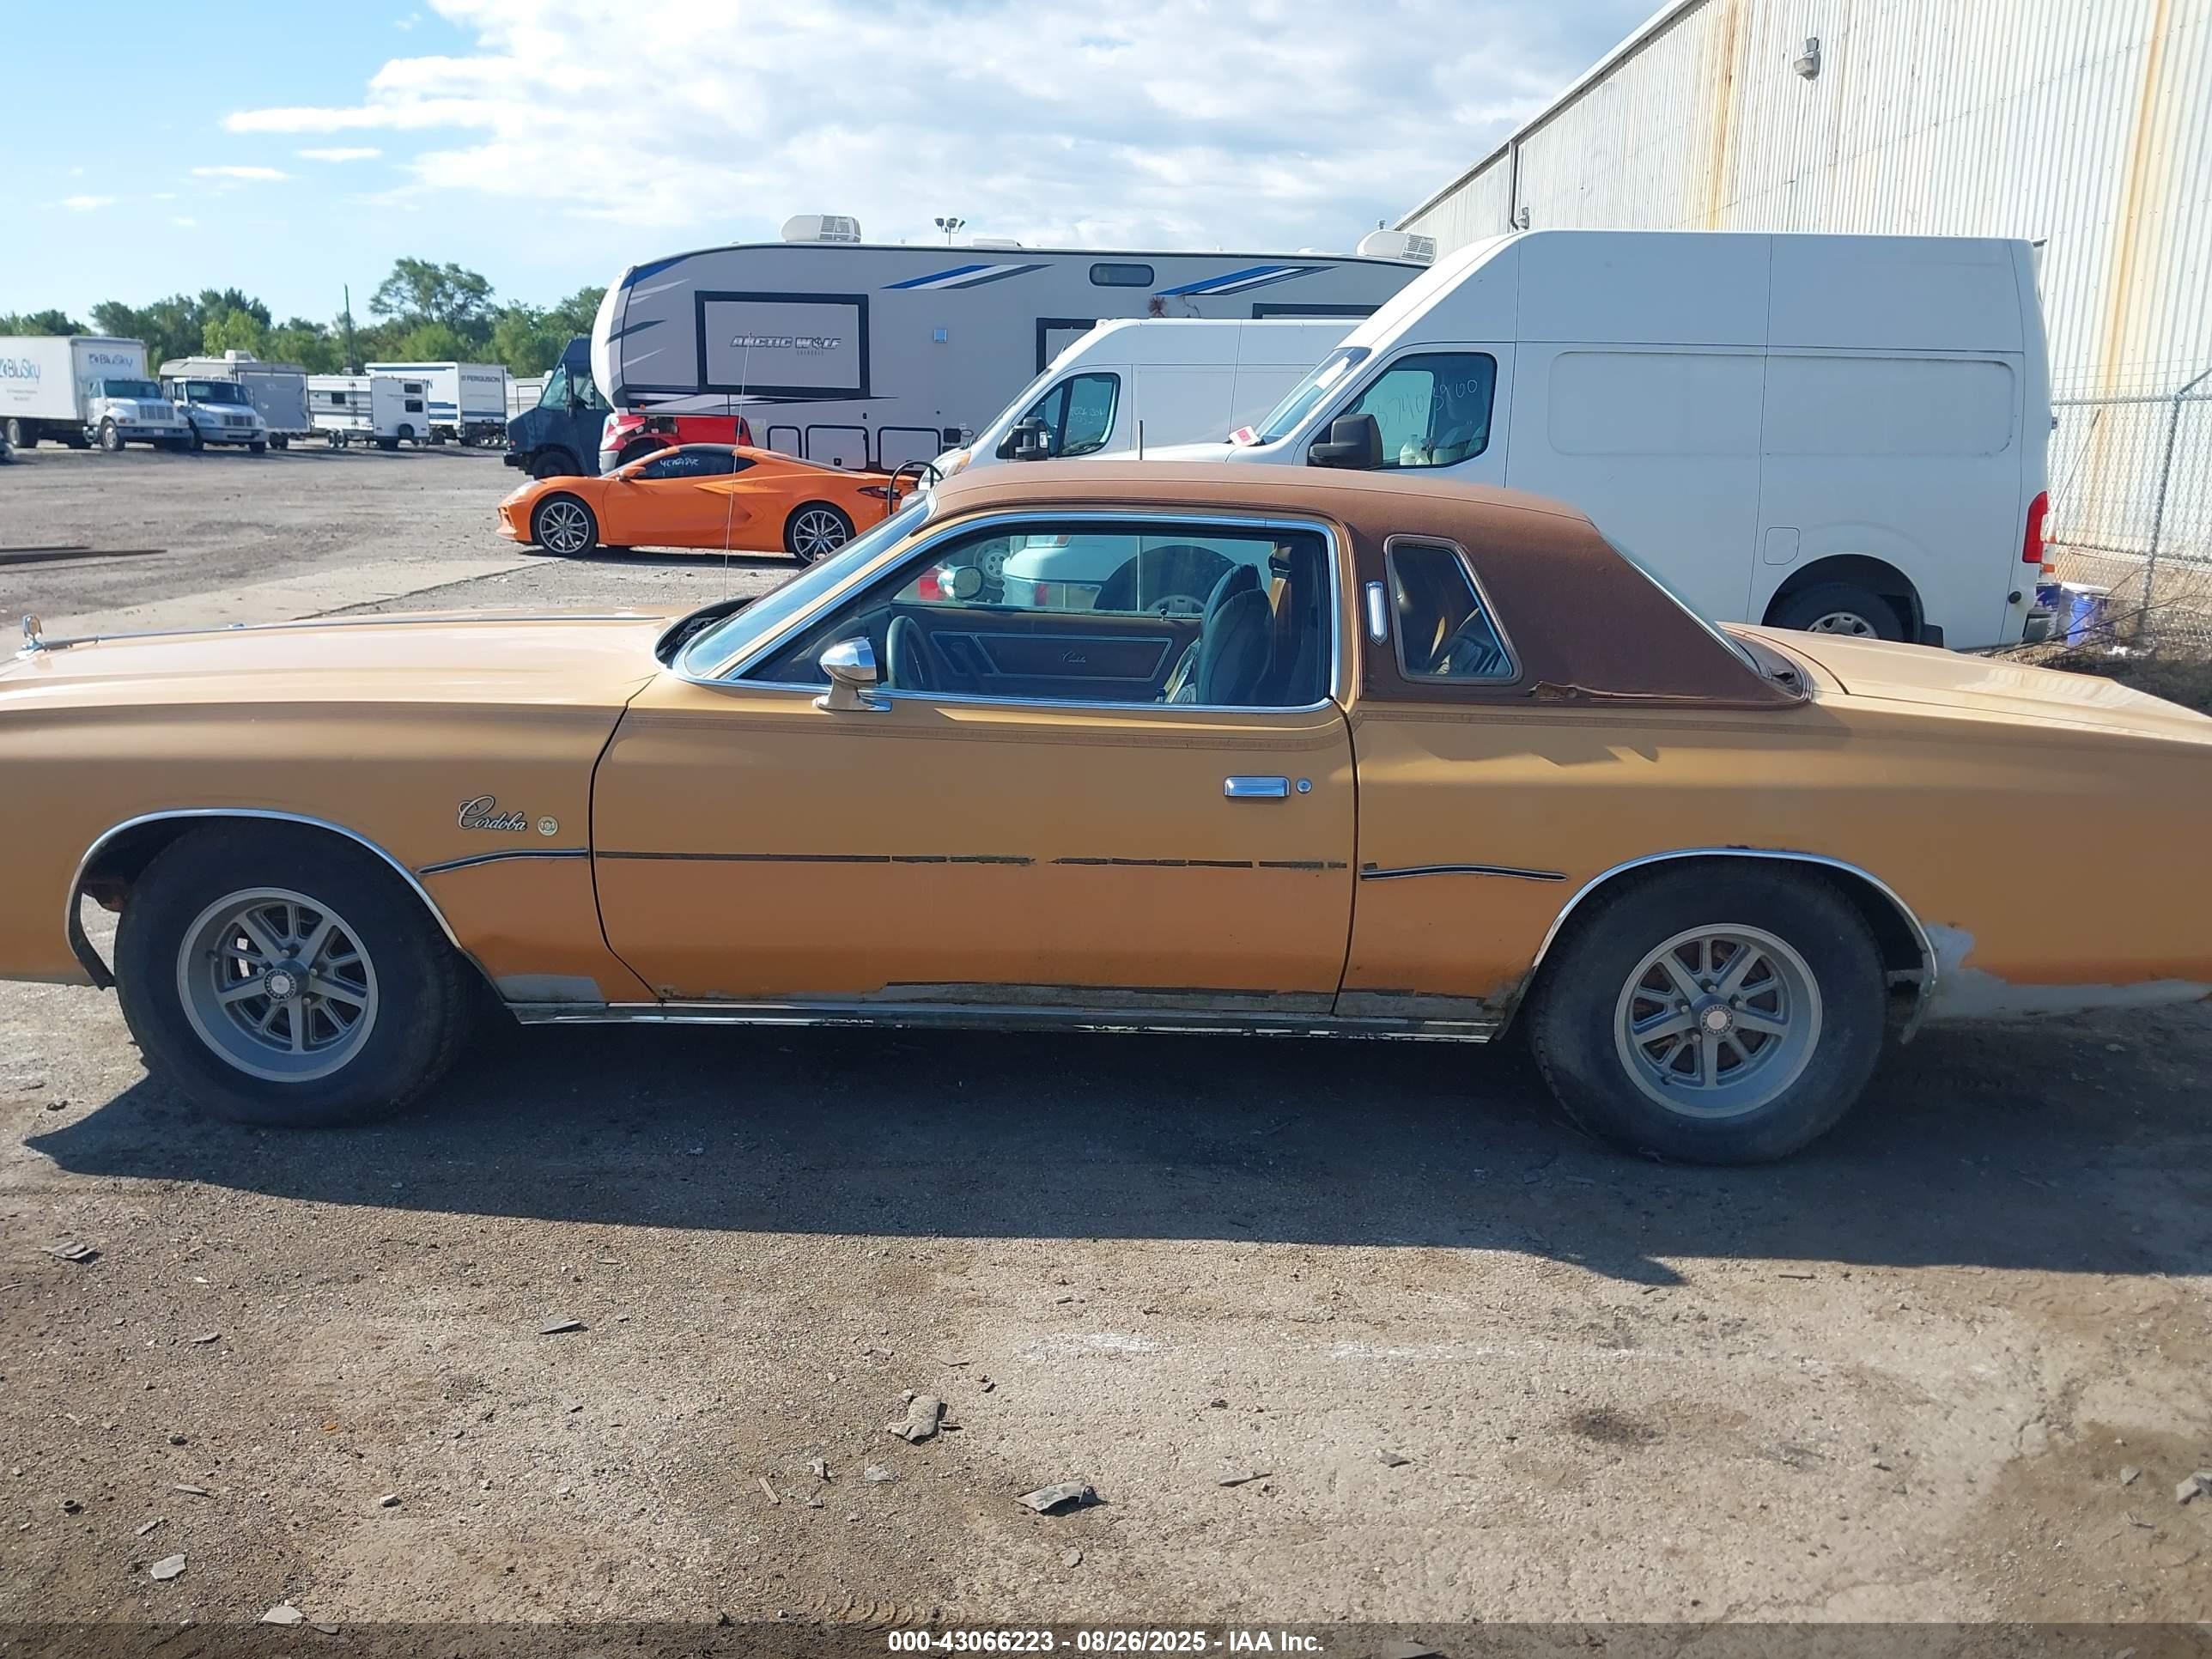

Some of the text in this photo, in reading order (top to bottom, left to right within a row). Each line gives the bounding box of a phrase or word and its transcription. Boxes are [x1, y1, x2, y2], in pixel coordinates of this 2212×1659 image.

[730, 336, 793, 348] ARCTIC
[100, 353, 133, 368] BluSky
[8, 358, 41, 385] BluSky
[466, 374, 501, 383] FERGUSON
[458, 795, 528, 831] Cordoba
